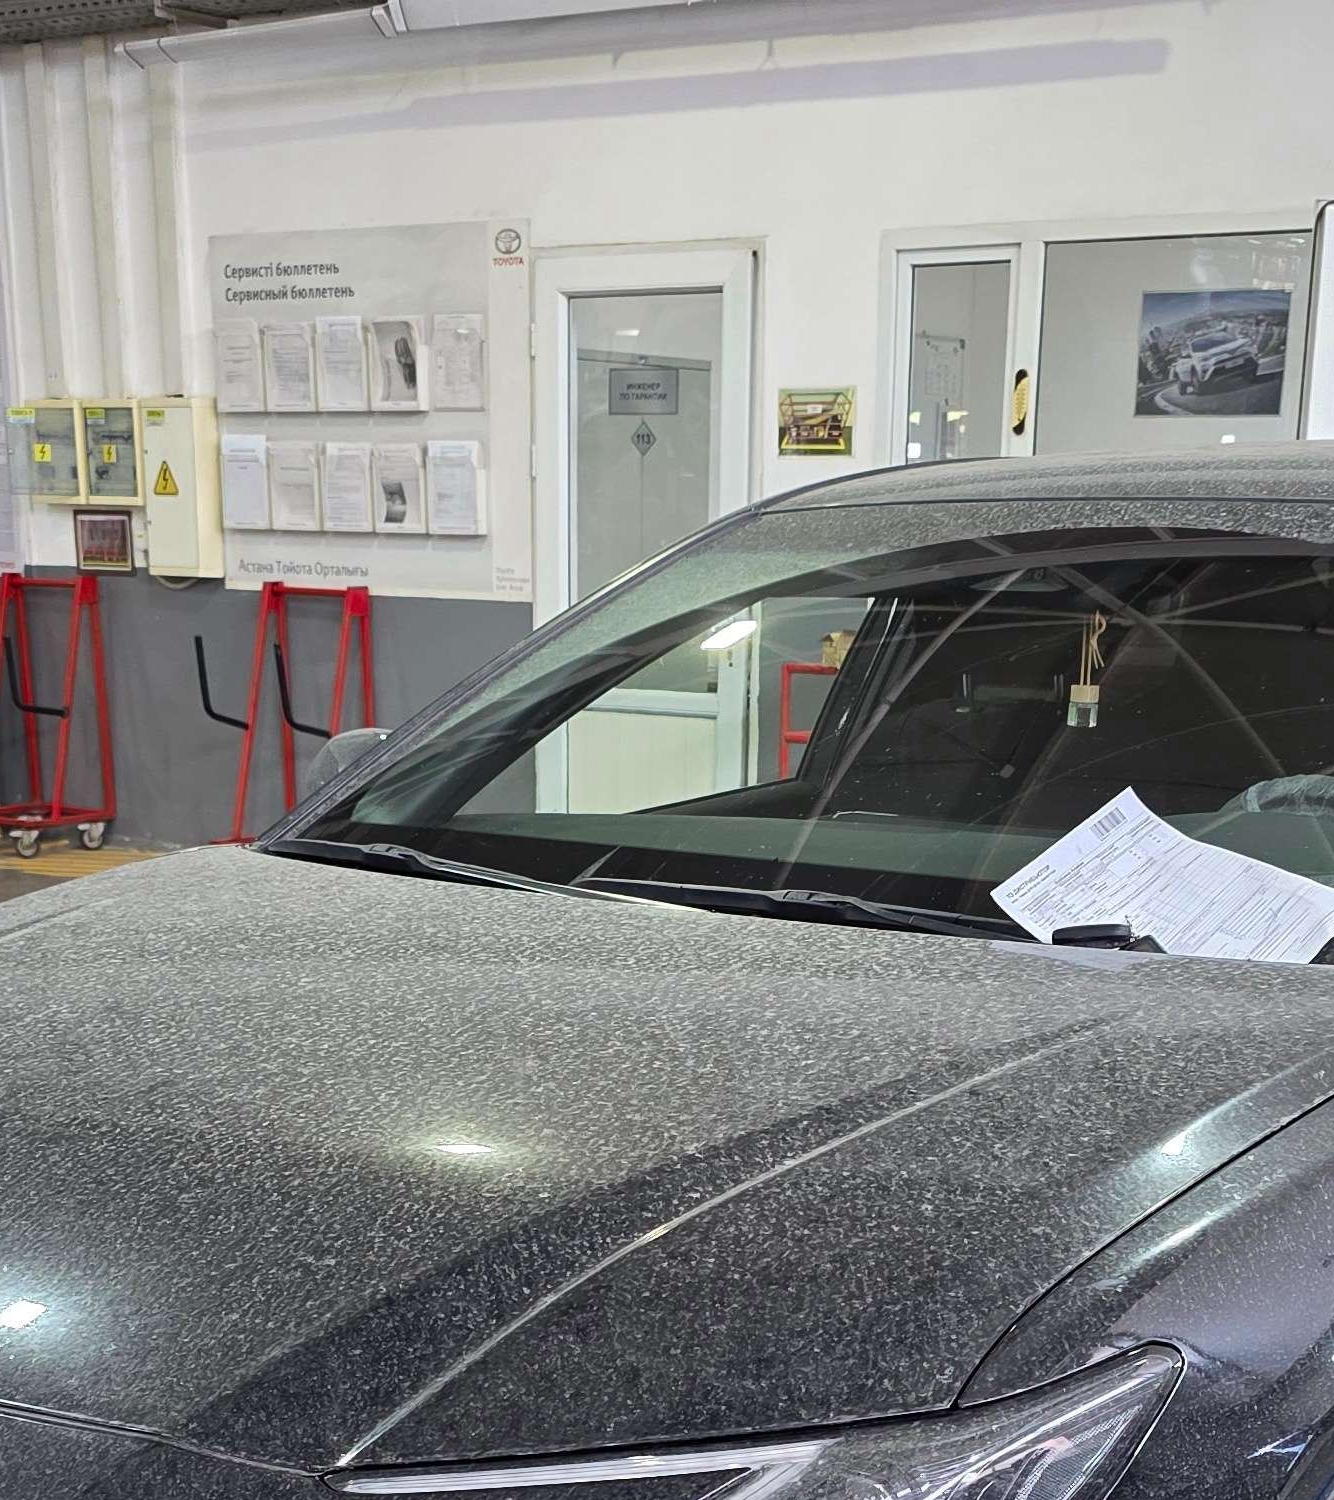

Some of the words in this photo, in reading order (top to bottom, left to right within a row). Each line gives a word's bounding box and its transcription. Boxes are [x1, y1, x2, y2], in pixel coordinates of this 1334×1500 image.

[493, 256, 524, 267] TOYOTA
[224, 262, 273, 282] Сервисті
[276, 262, 340, 277] бюллетень
[225, 285, 288, 305] Сервисный
[291, 284, 355, 299] бюллетень
[627, 382, 661, 391] ИНЖЕНЕР
[636, 433, 651, 445] 113
[239, 559, 273, 574] Астана
[275, 560, 312, 575] Тойота
